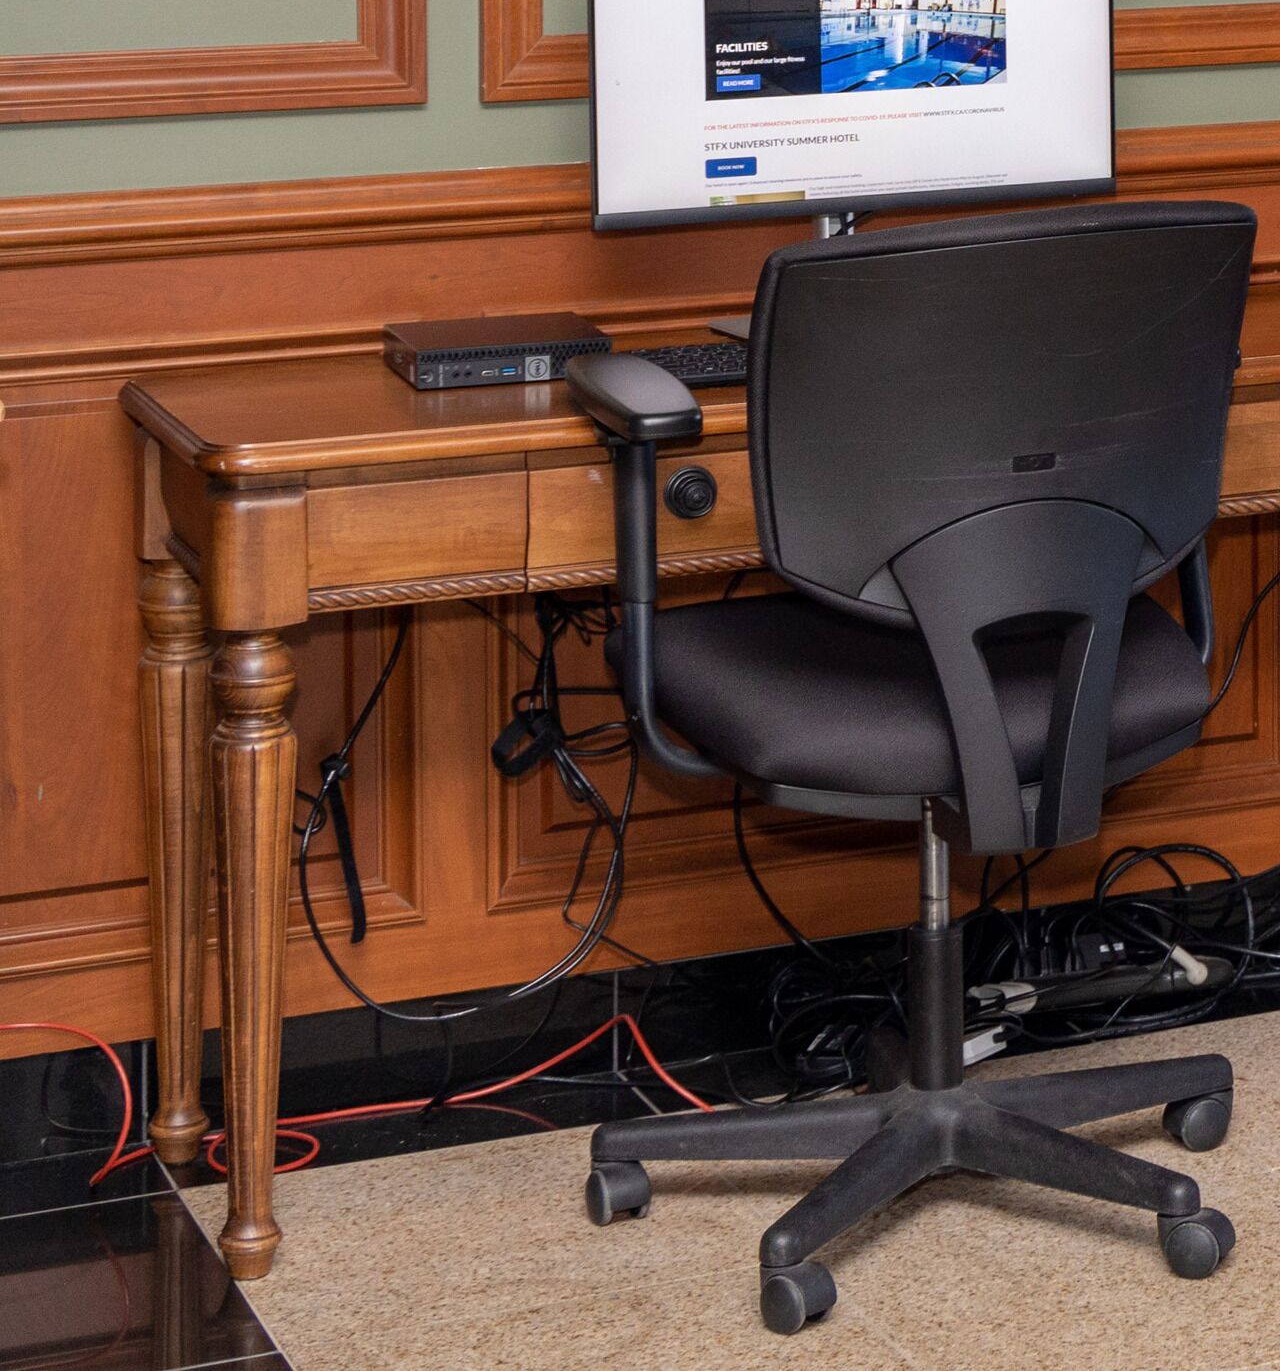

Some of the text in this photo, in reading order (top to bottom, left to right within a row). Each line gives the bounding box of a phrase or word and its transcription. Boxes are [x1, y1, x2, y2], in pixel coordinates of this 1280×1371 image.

[716, 41, 769, 53] FACILITIES
[704, 133, 861, 152] STFX UNIVERSITY SUMMER HOTEL
